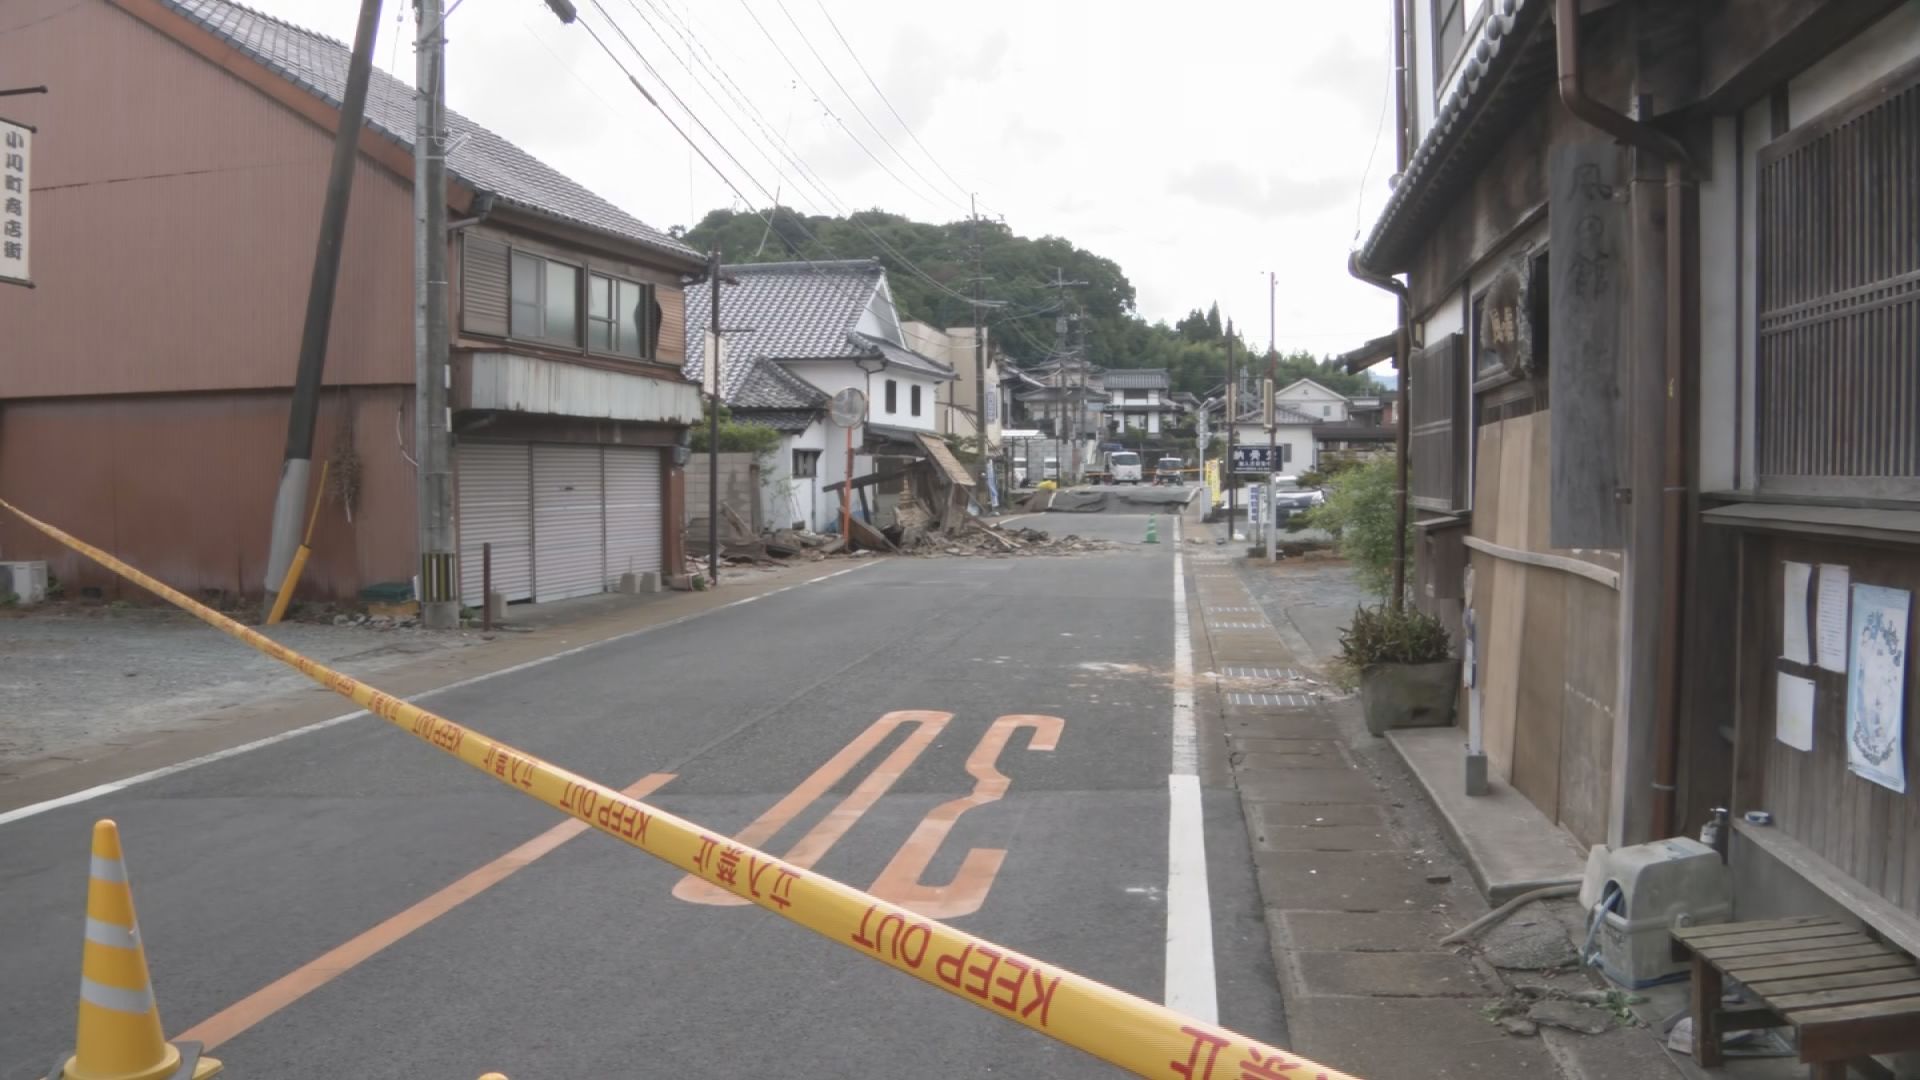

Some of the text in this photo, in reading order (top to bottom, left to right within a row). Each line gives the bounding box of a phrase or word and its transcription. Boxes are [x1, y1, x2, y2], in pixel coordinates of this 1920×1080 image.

[4, 131, 24, 260] 小川町商店街
[560, 781, 652, 844] KEEP OUT
[672, 710, 1065, 920] 30
[693, 835, 800, 909] 立入禁止
[851, 904, 1061, 1026] KEEP OUT
